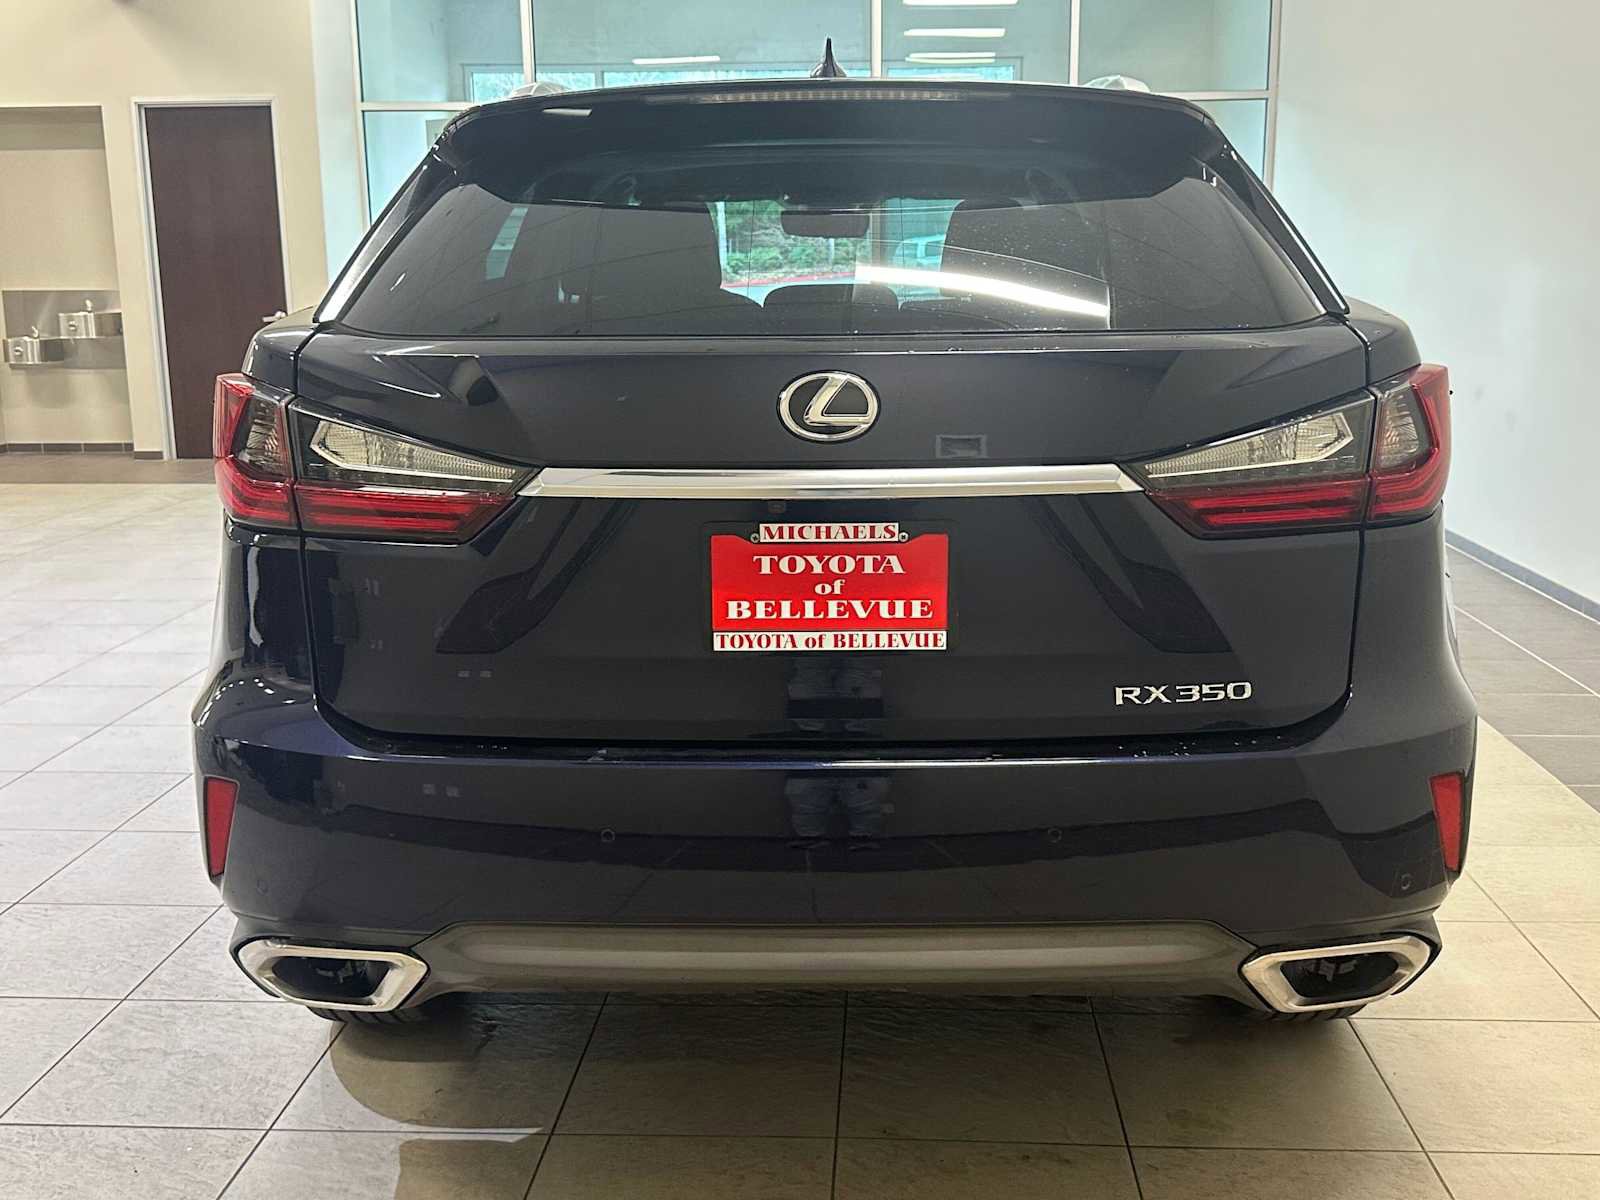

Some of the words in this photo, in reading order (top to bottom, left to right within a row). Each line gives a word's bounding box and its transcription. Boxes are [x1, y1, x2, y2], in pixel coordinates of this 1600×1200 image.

[763, 525, 897, 540] MICHAELS
[753, 554, 906, 575] TOYOTA
[814, 578, 846, 595] of
[725, 599, 934, 620] BELLEVUE
[715, 633, 798, 649] TOYOTA
[804, 633, 827, 649] of
[833, 632, 945, 649] BELLEVUE
